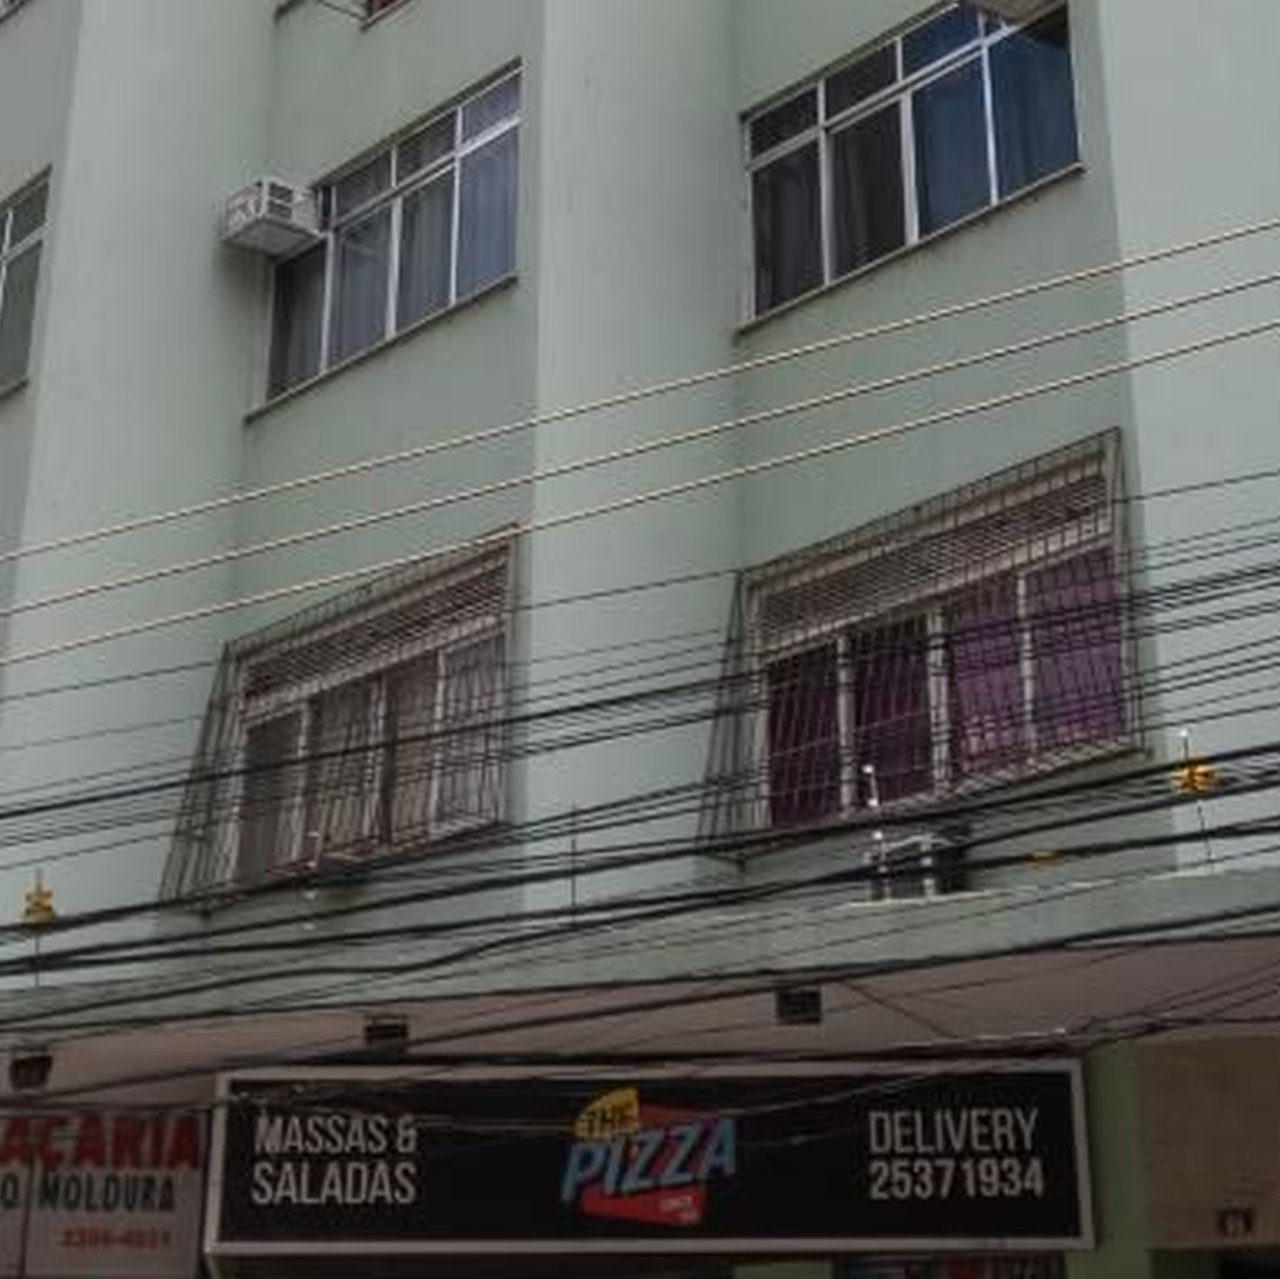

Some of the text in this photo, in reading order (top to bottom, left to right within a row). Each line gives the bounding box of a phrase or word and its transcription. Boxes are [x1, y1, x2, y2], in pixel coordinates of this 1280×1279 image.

[252, 1113, 418, 1155] MASSAS &
[869, 1108, 1040, 1153] DELIVERY
[560, 1118, 737, 1201] PIZZA
[869, 1157, 1044, 1200] 25371934
[37, 1173, 177, 1212] MOLDURA
[251, 1159, 417, 1206] SALADAS
